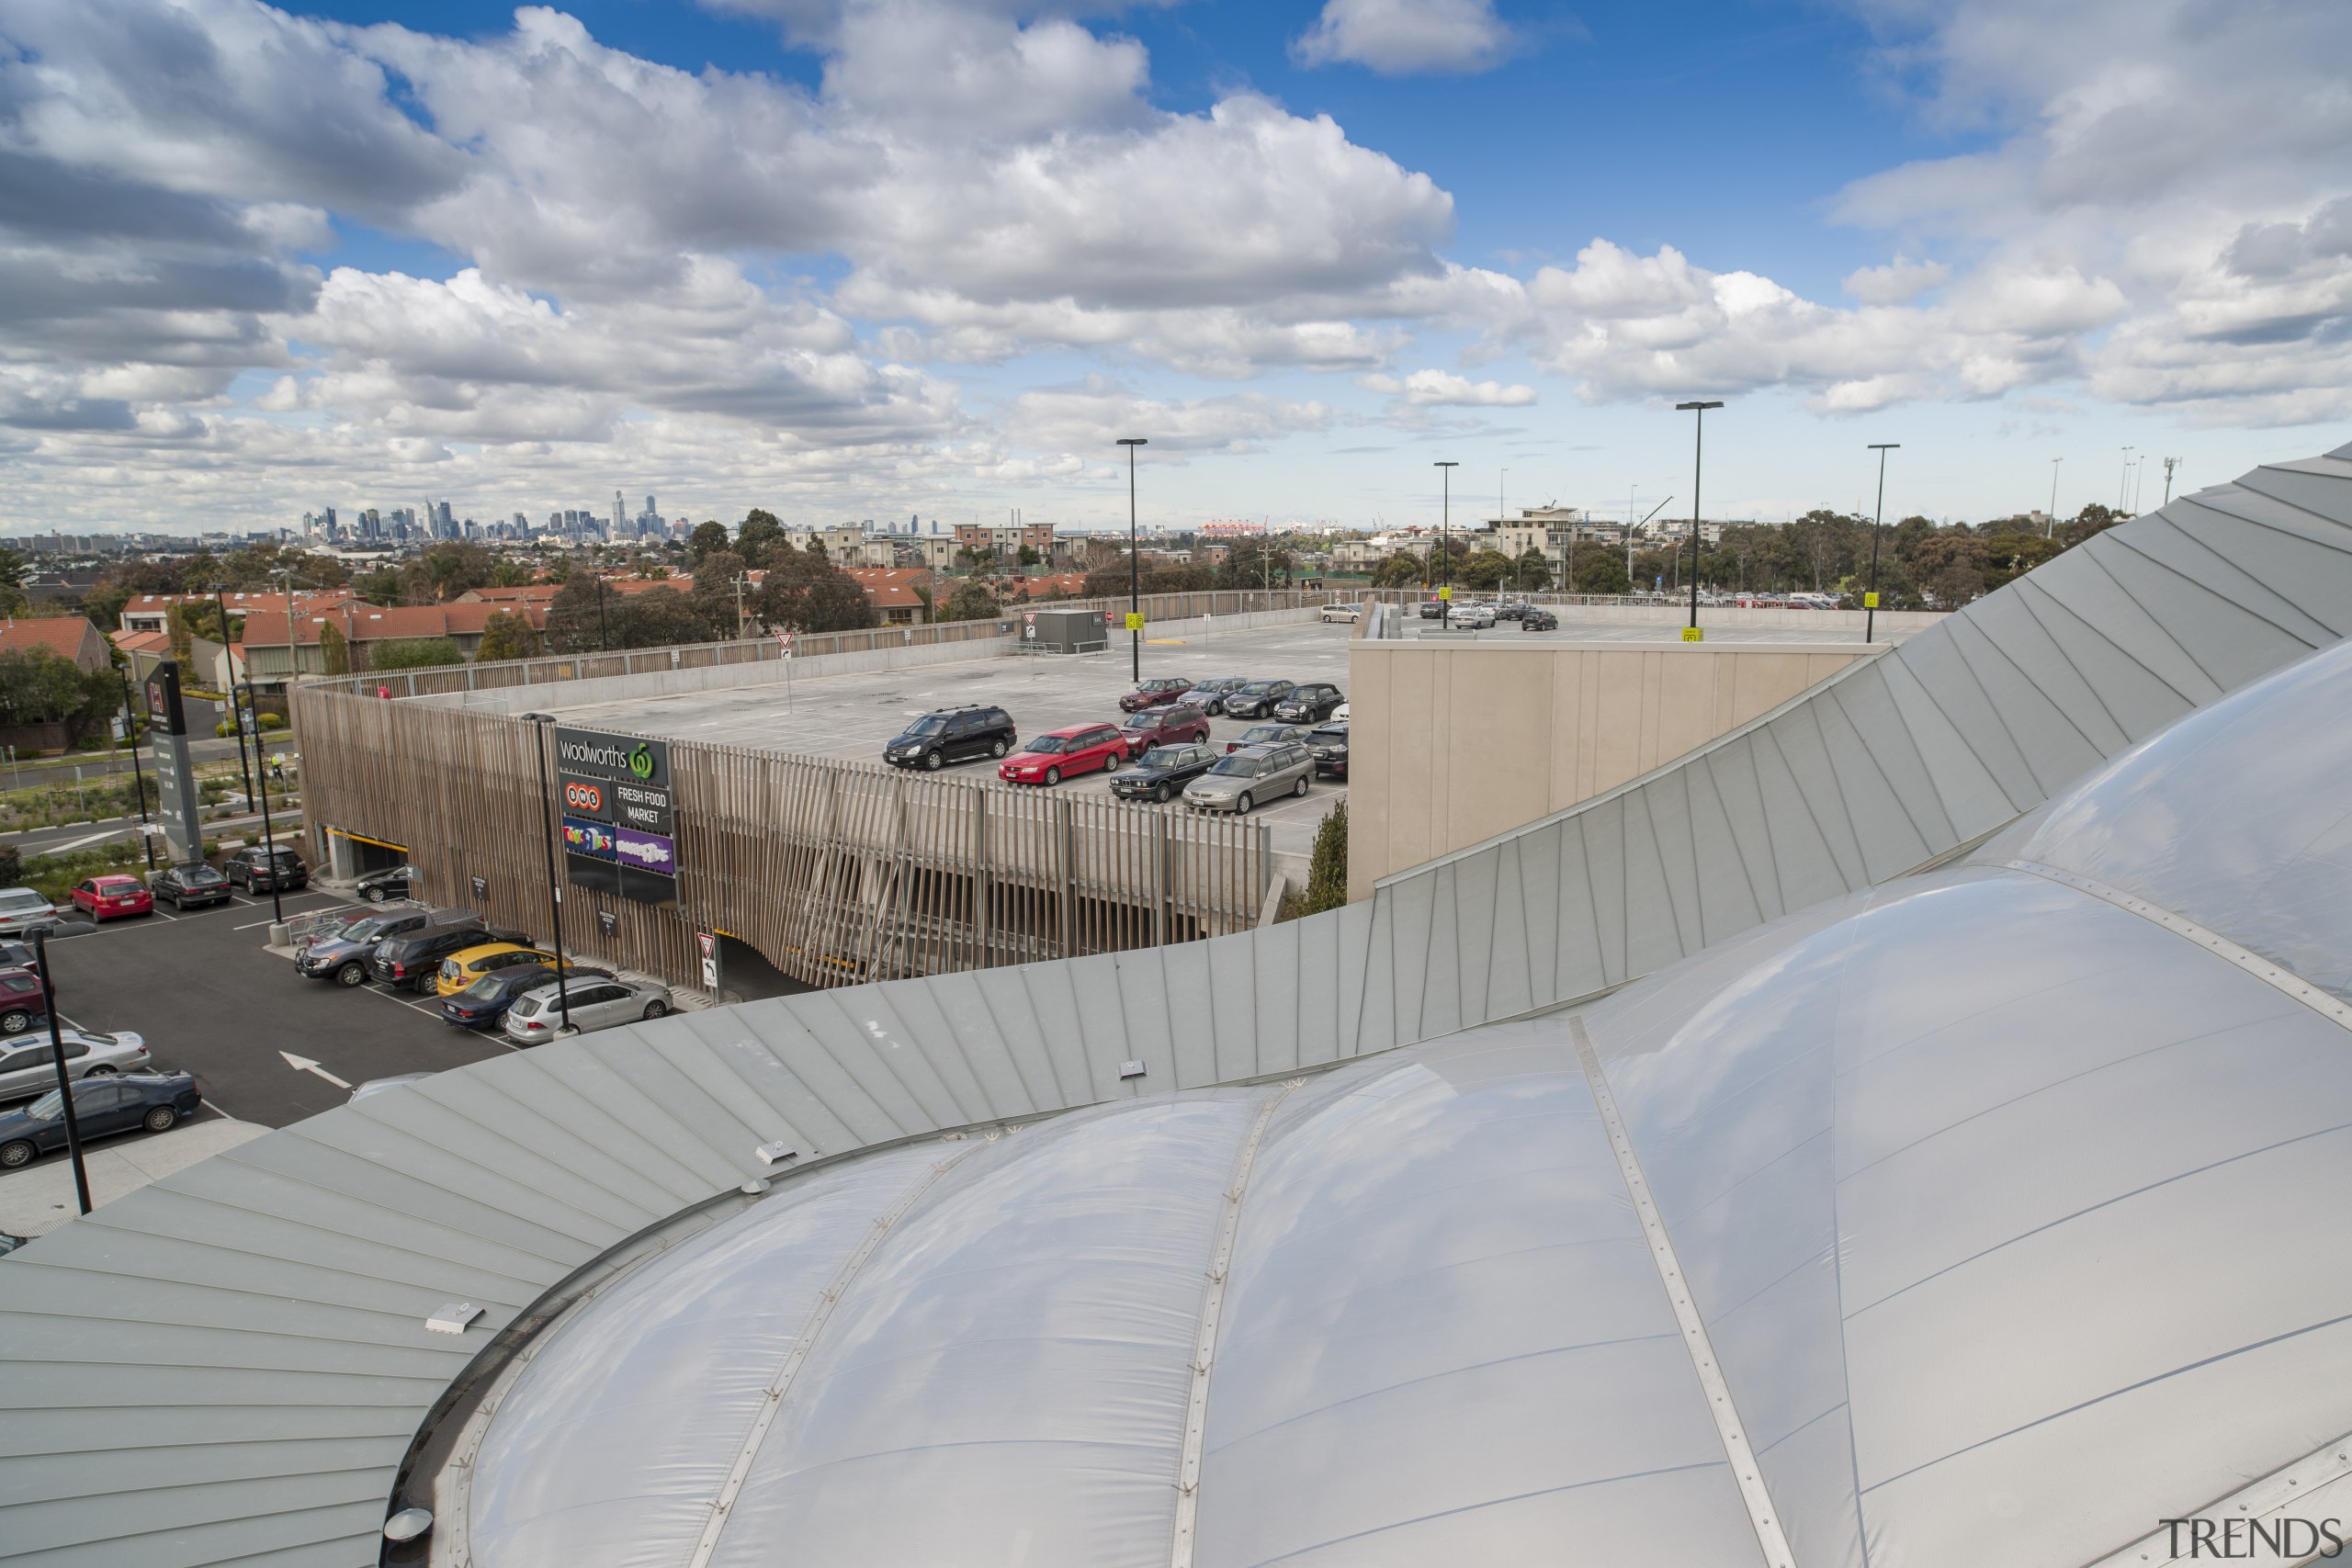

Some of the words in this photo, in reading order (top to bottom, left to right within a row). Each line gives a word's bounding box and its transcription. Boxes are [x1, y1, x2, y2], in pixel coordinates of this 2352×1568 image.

[560, 740, 627, 768] Woolworths
[617, 786, 643, 803] FRESH
[644, 791, 666, 807] FOOD
[628, 806, 659, 823] MARKET
